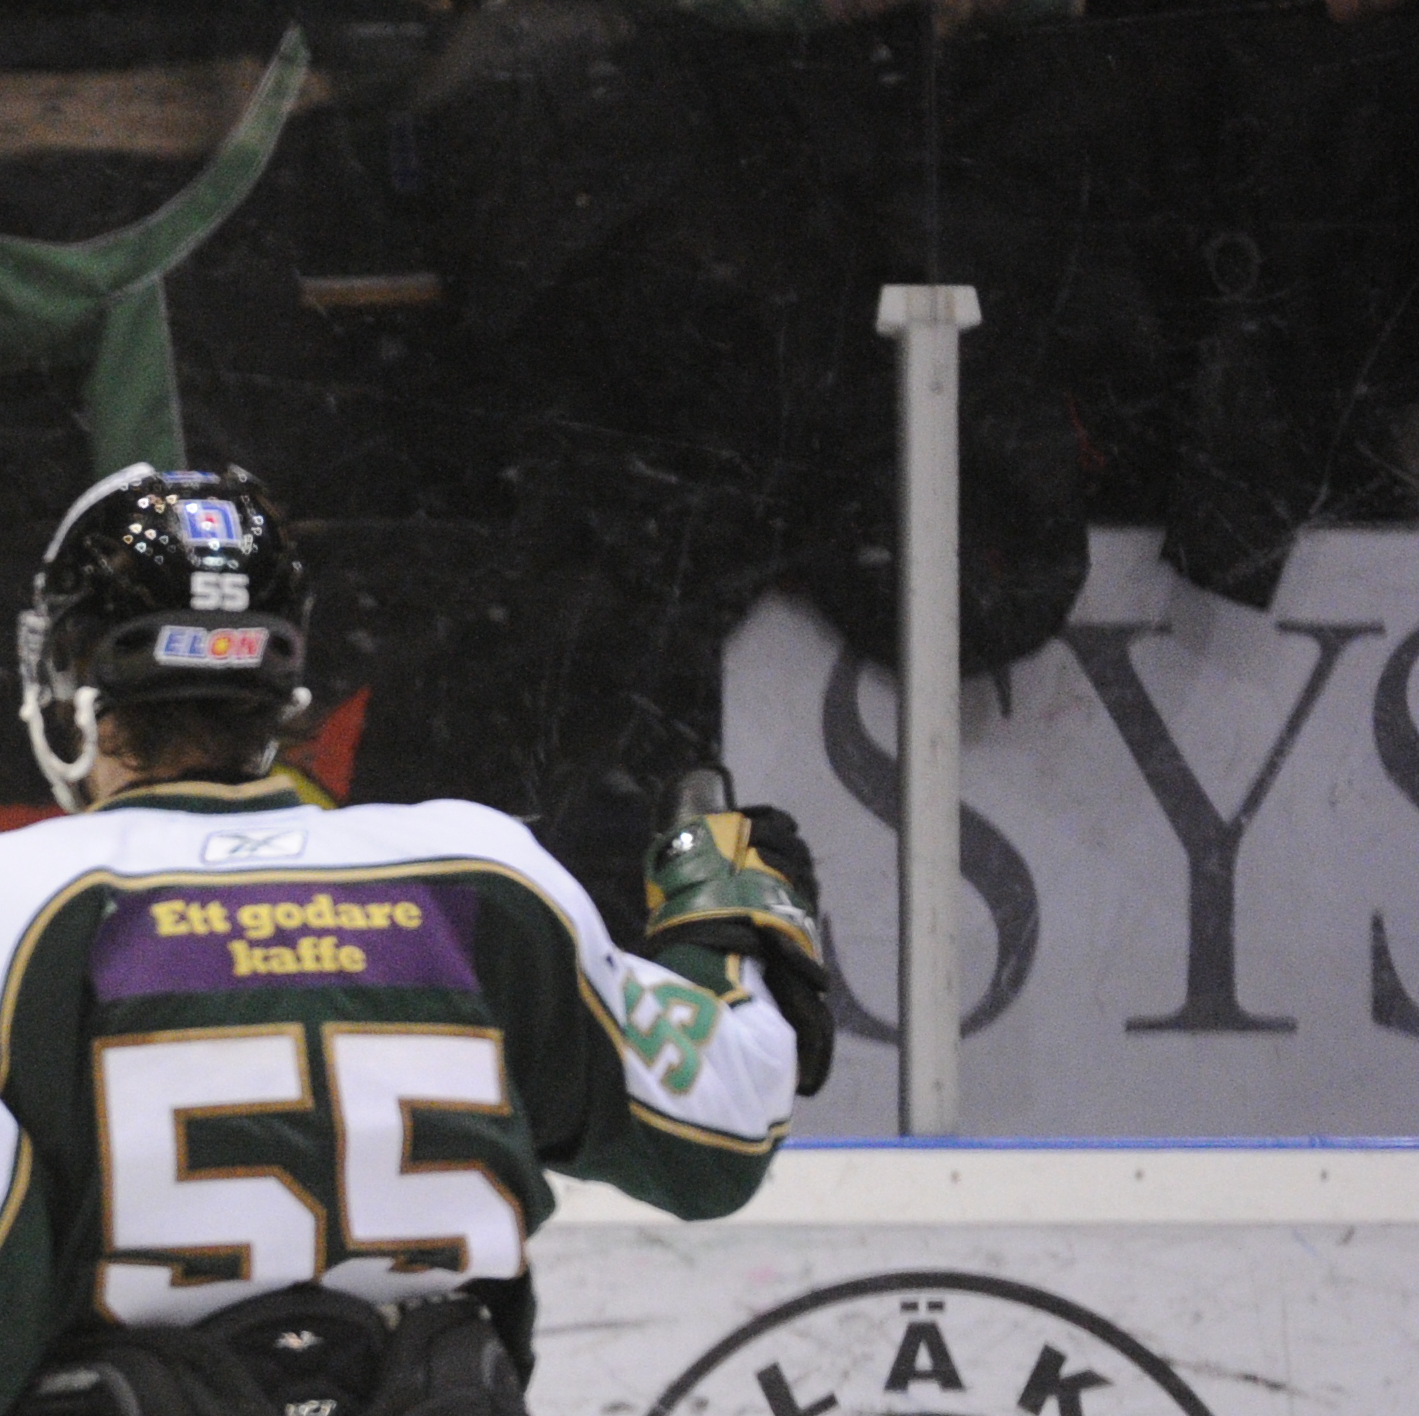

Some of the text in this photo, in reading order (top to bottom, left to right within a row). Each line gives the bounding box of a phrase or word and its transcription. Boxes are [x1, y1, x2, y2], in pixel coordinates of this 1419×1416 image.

[190, 571, 250, 612] 55
[159, 626, 267, 665] ELON
[150, 893, 423, 940] Ett godare
[227, 935, 367, 977] kaffe
[94, 1025, 527, 1328] 55
